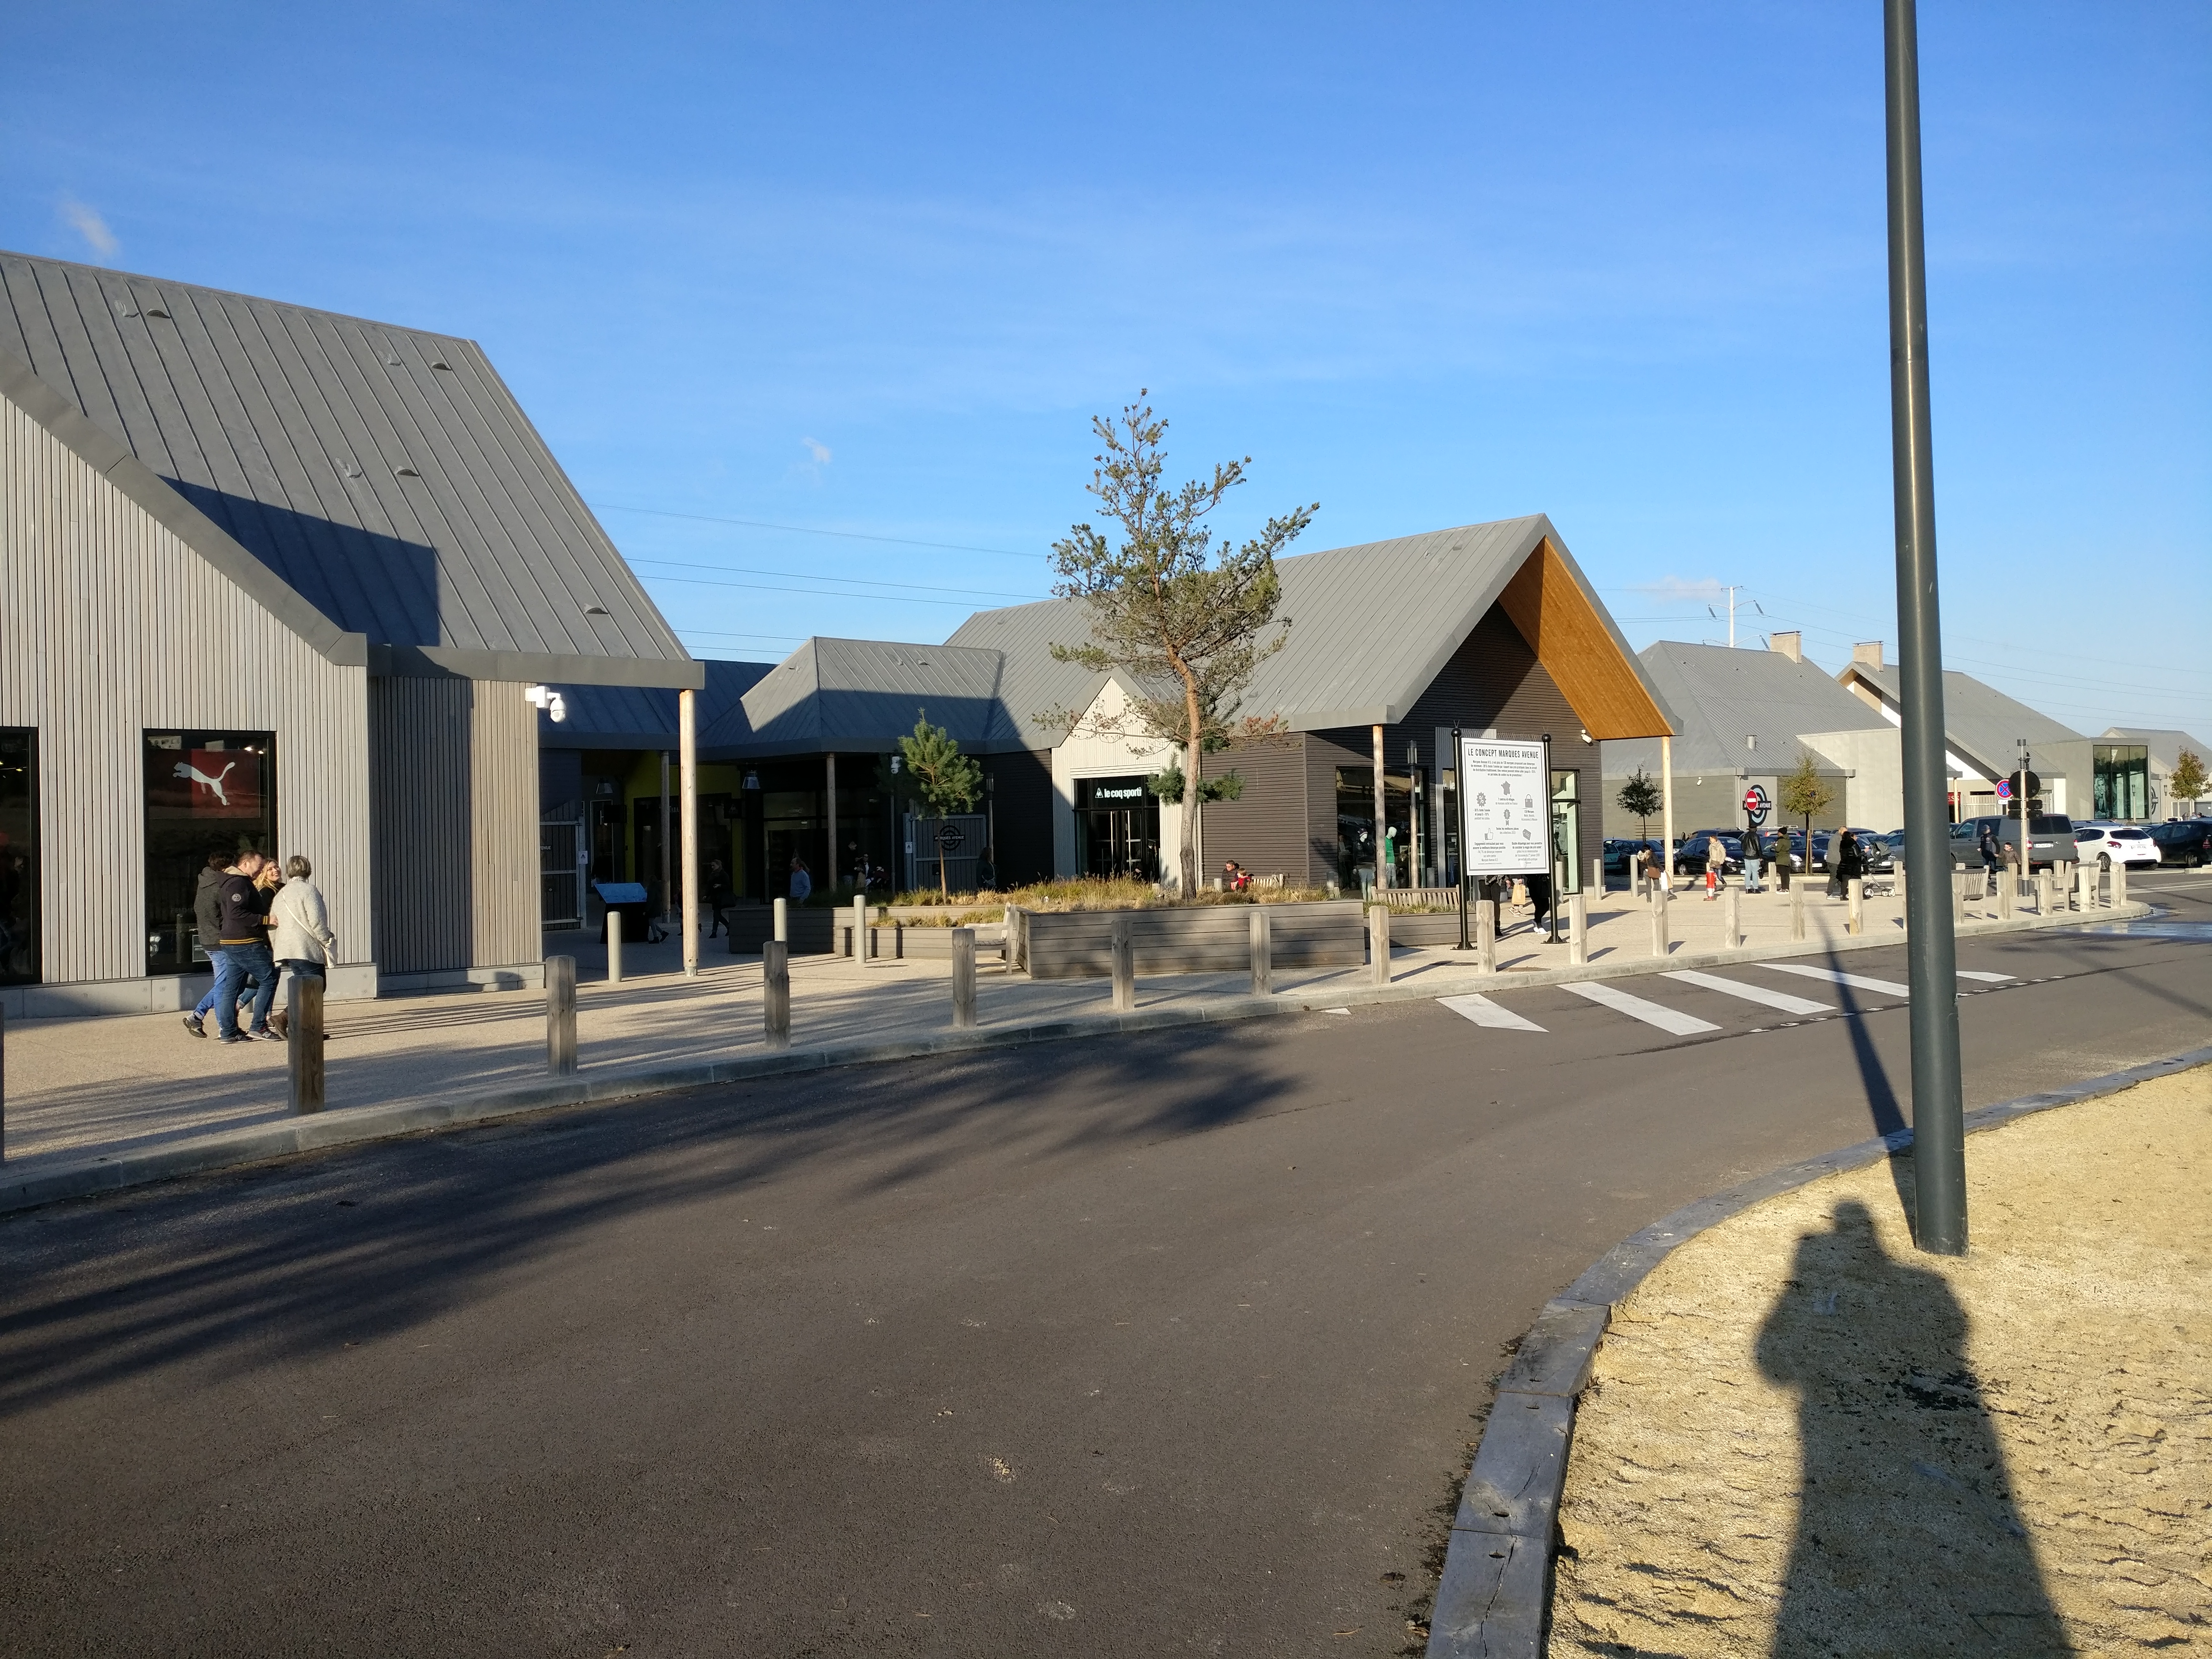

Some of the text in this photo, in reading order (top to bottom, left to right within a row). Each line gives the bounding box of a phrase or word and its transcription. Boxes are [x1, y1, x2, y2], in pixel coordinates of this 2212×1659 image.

[1499, 750, 1520, 758] MARQUES
[1522, 751, 1539, 759] AVENUE
[1104, 787, 1142, 799] le coq sporti
